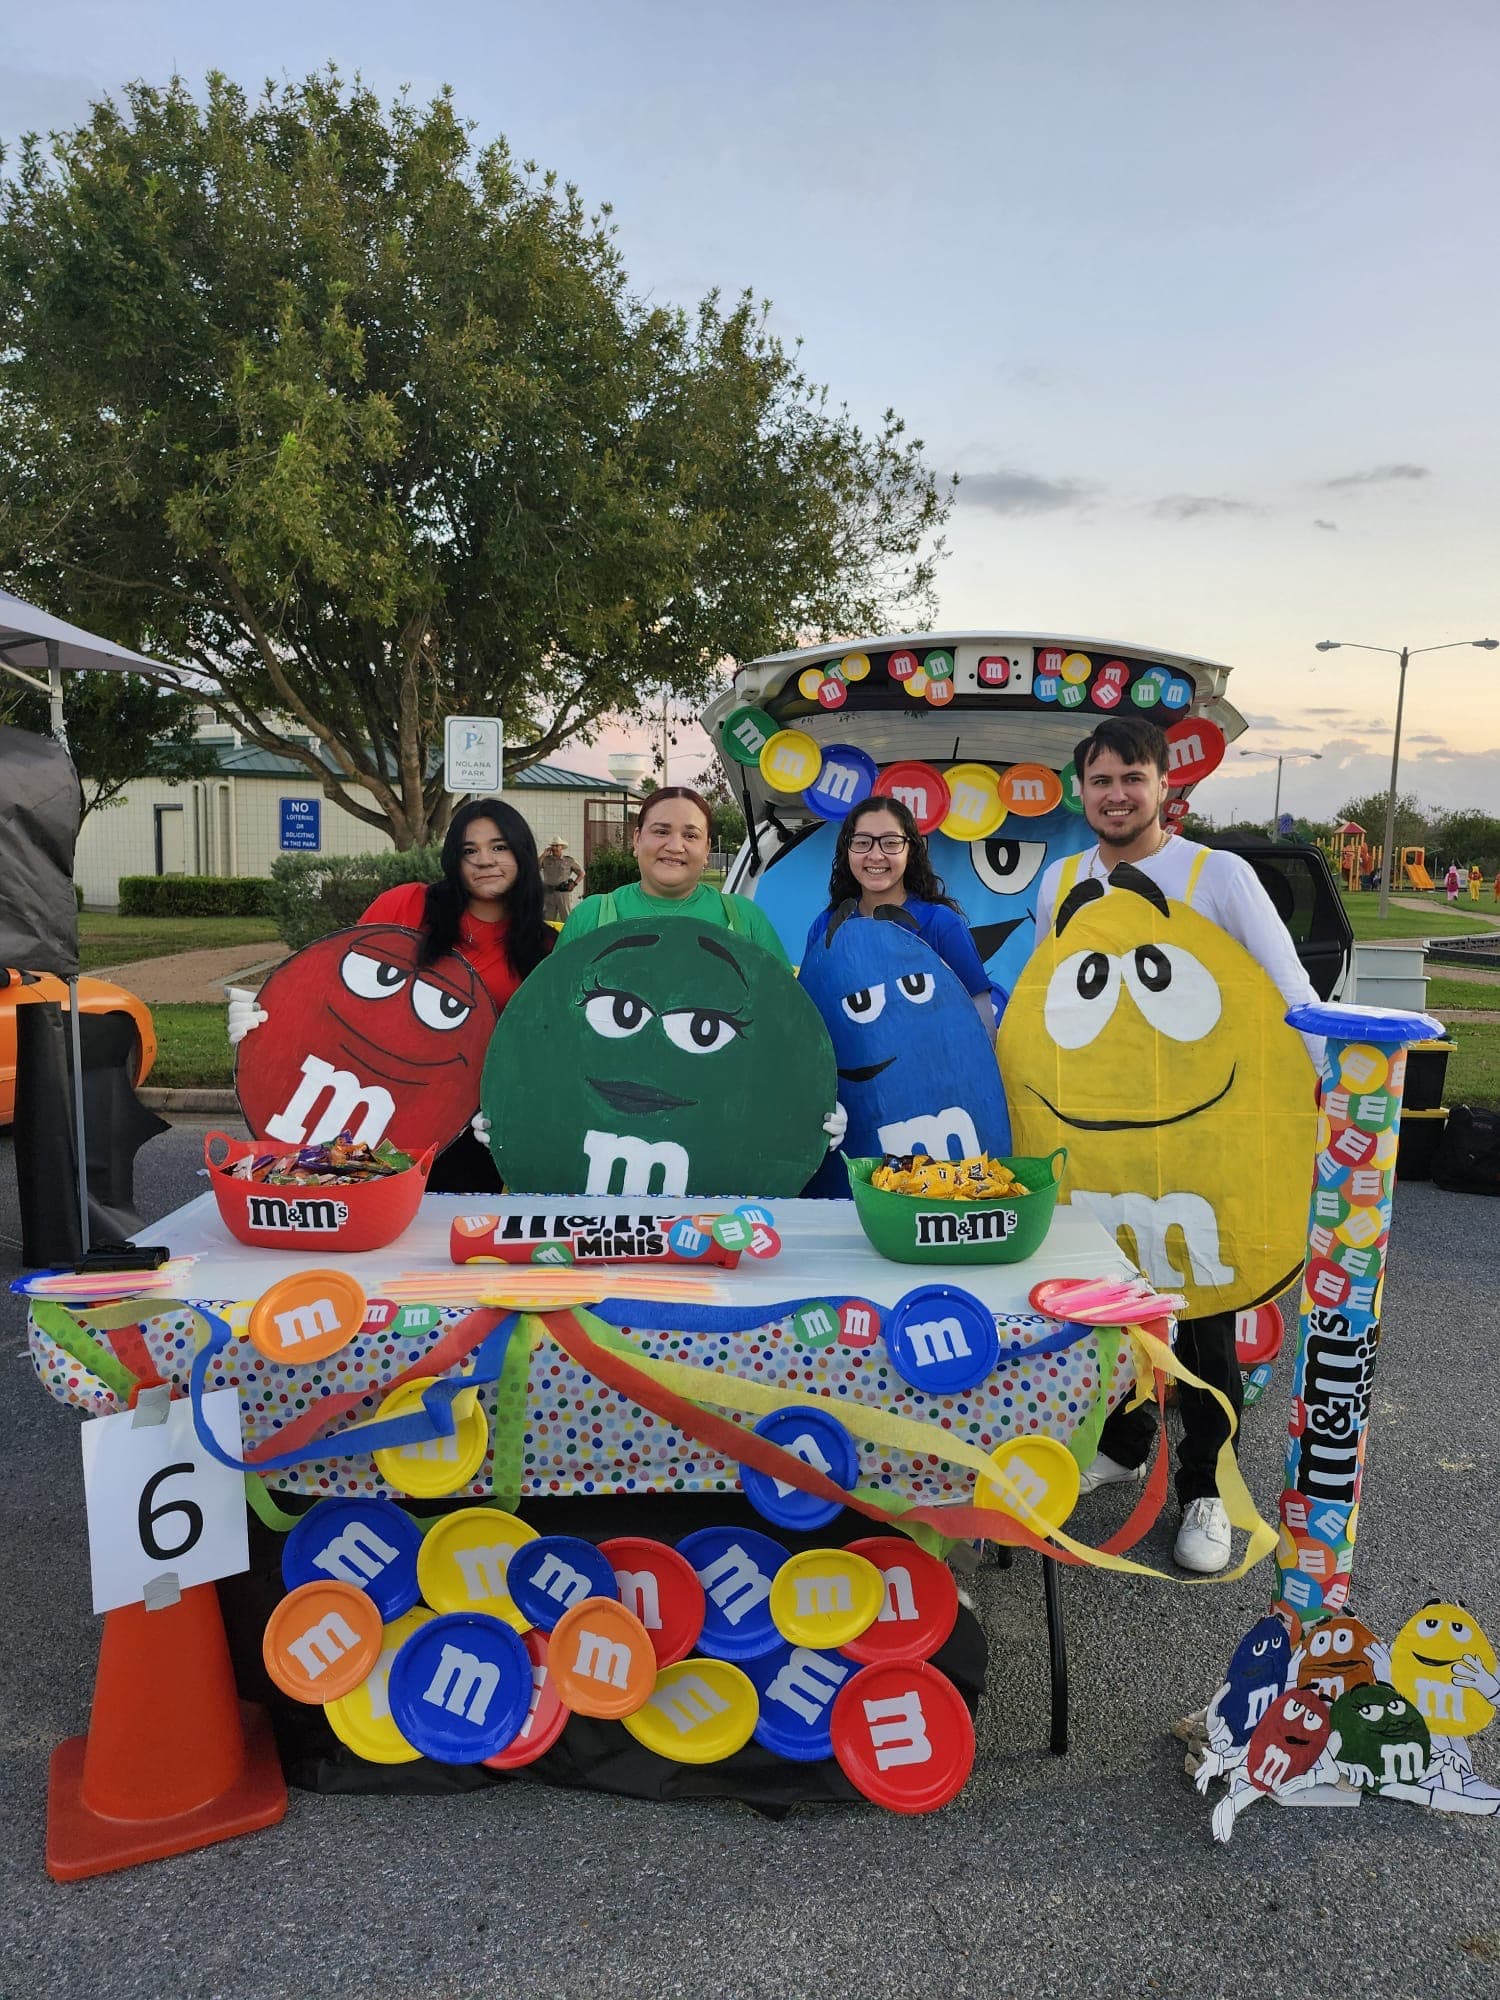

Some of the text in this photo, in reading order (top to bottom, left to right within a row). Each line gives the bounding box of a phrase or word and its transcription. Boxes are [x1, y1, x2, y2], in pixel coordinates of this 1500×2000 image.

[894, 656, 912, 675] m
[929, 656, 949, 676] m
[986, 662, 1003, 679] m
[1045, 653, 1062, 670] m
[1138, 684, 1155, 702] m
[1166, 685, 1184, 703] m
[732, 718, 766, 754] m
[455, 759, 491, 768] NOLANA
[461, 769, 485, 777] PARK
[817, 760, 860, 804] m
[1011, 778, 1047, 801] m
[291, 802, 309, 813] NO
[264, 1054, 397, 1150] m
[1357, 1095, 1388, 1123] m
[1335, 1127, 1373, 1161] m
[583, 1129, 690, 1196] m
[1352, 1170, 1380, 1196] m
[250, 1198, 348, 1228] m&m's
[1316, 1191, 1340, 1219] m
[676, 1224, 701, 1251] m
[718, 1220, 745, 1244] m
[918, 1210, 1017, 1244] m&m's
[1071, 1190, 1235, 1288] m
[1339, 1248, 1372, 1277] m
[1314, 1269, 1346, 1303] m
[1346, 1285, 1375, 1312] m
[274, 1298, 341, 1348] m
[403, 1308, 430, 1328] m
[802, 1308, 833, 1339] m
[844, 1308, 871, 1337] m
[905, 1317, 972, 1368] m
[138, 1462, 203, 1560] 6
[1314, 1509, 1348, 1540] m
[312, 1521, 401, 1590] m
[1298, 1549, 1326, 1574] m
[529, 1553, 594, 1609] m
[697, 1543, 771, 1626] m
[793, 1574, 854, 1617] m
[1284, 1576, 1311, 1607] m
[286, 1612, 362, 1680] m
[572, 1630, 633, 1690] m
[422, 1644, 501, 1726] m
[764, 1647, 849, 1726] m
[1414, 1678, 1467, 1723] m
[863, 1690, 933, 1771] m
[1253, 1744, 1291, 1788] m
[1380, 1742, 1426, 1785] m
